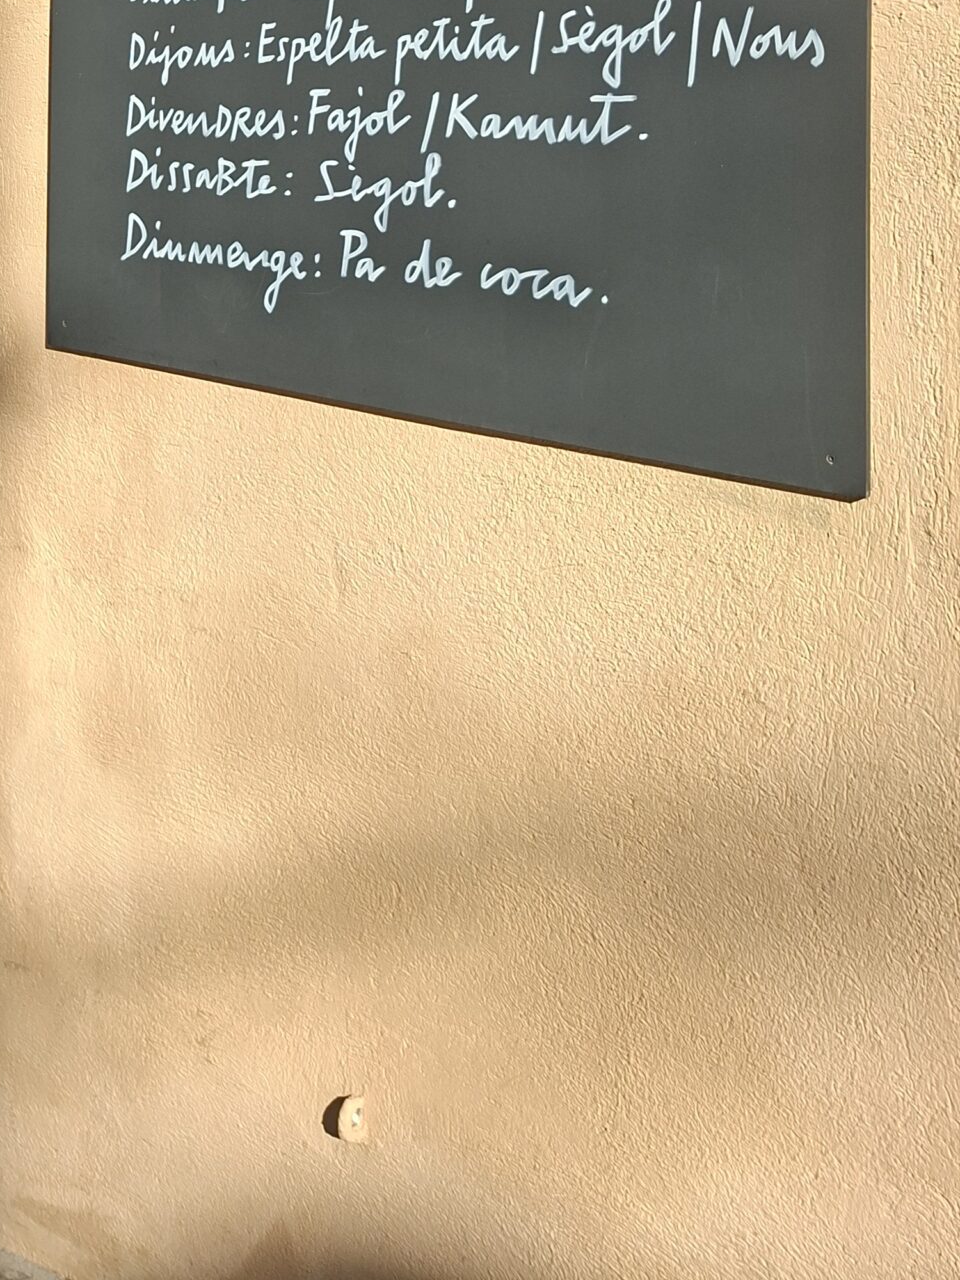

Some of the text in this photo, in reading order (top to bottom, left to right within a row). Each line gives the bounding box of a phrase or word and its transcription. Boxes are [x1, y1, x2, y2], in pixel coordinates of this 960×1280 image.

[256, 17, 388, 86] Espelta
[395, 14, 519, 86] petita
[711, 5, 827, 68] Nous
[307, 87, 412, 162] Fajol
[340, 228, 386, 282] Pa
[404, 238, 461, 287] de
[480, 262, 610, 308] coca.
